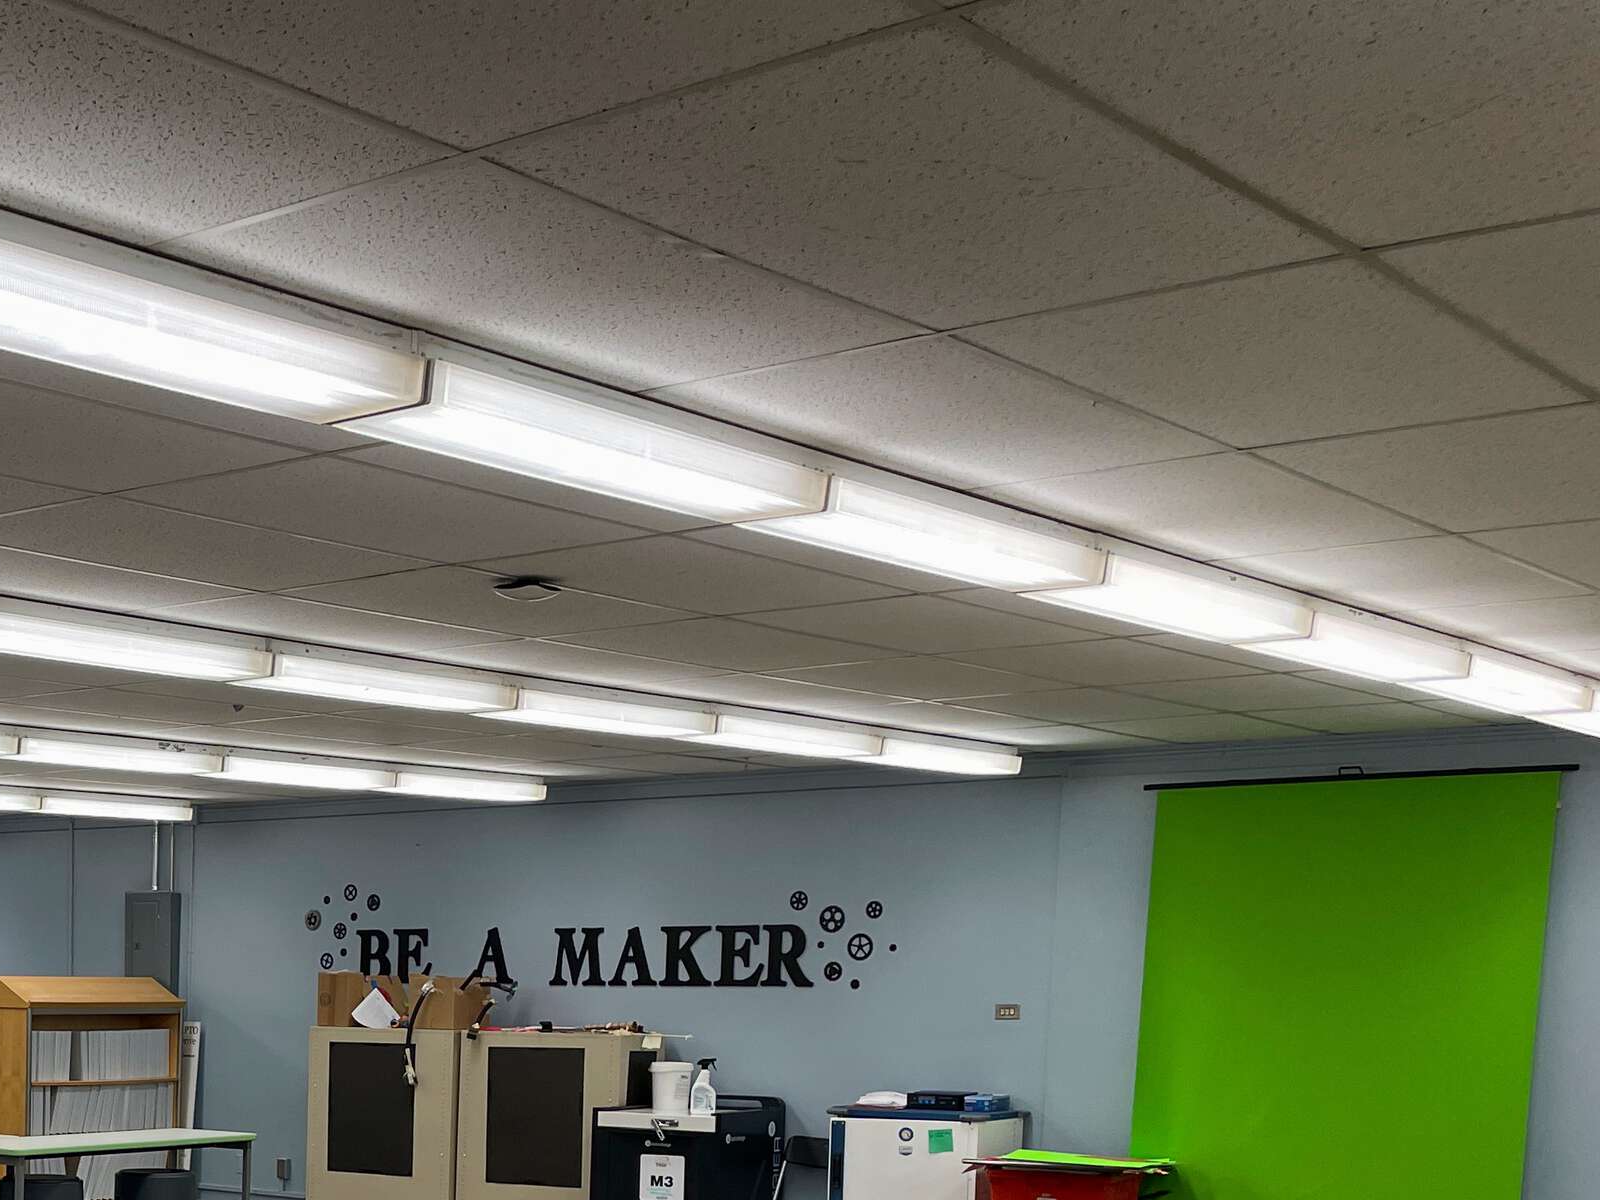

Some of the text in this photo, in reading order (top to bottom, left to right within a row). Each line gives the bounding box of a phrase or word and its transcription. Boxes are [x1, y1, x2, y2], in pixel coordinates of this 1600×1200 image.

[356, 924, 815, 990] BE A MAKER
[650, 1174, 674, 1188] M3
